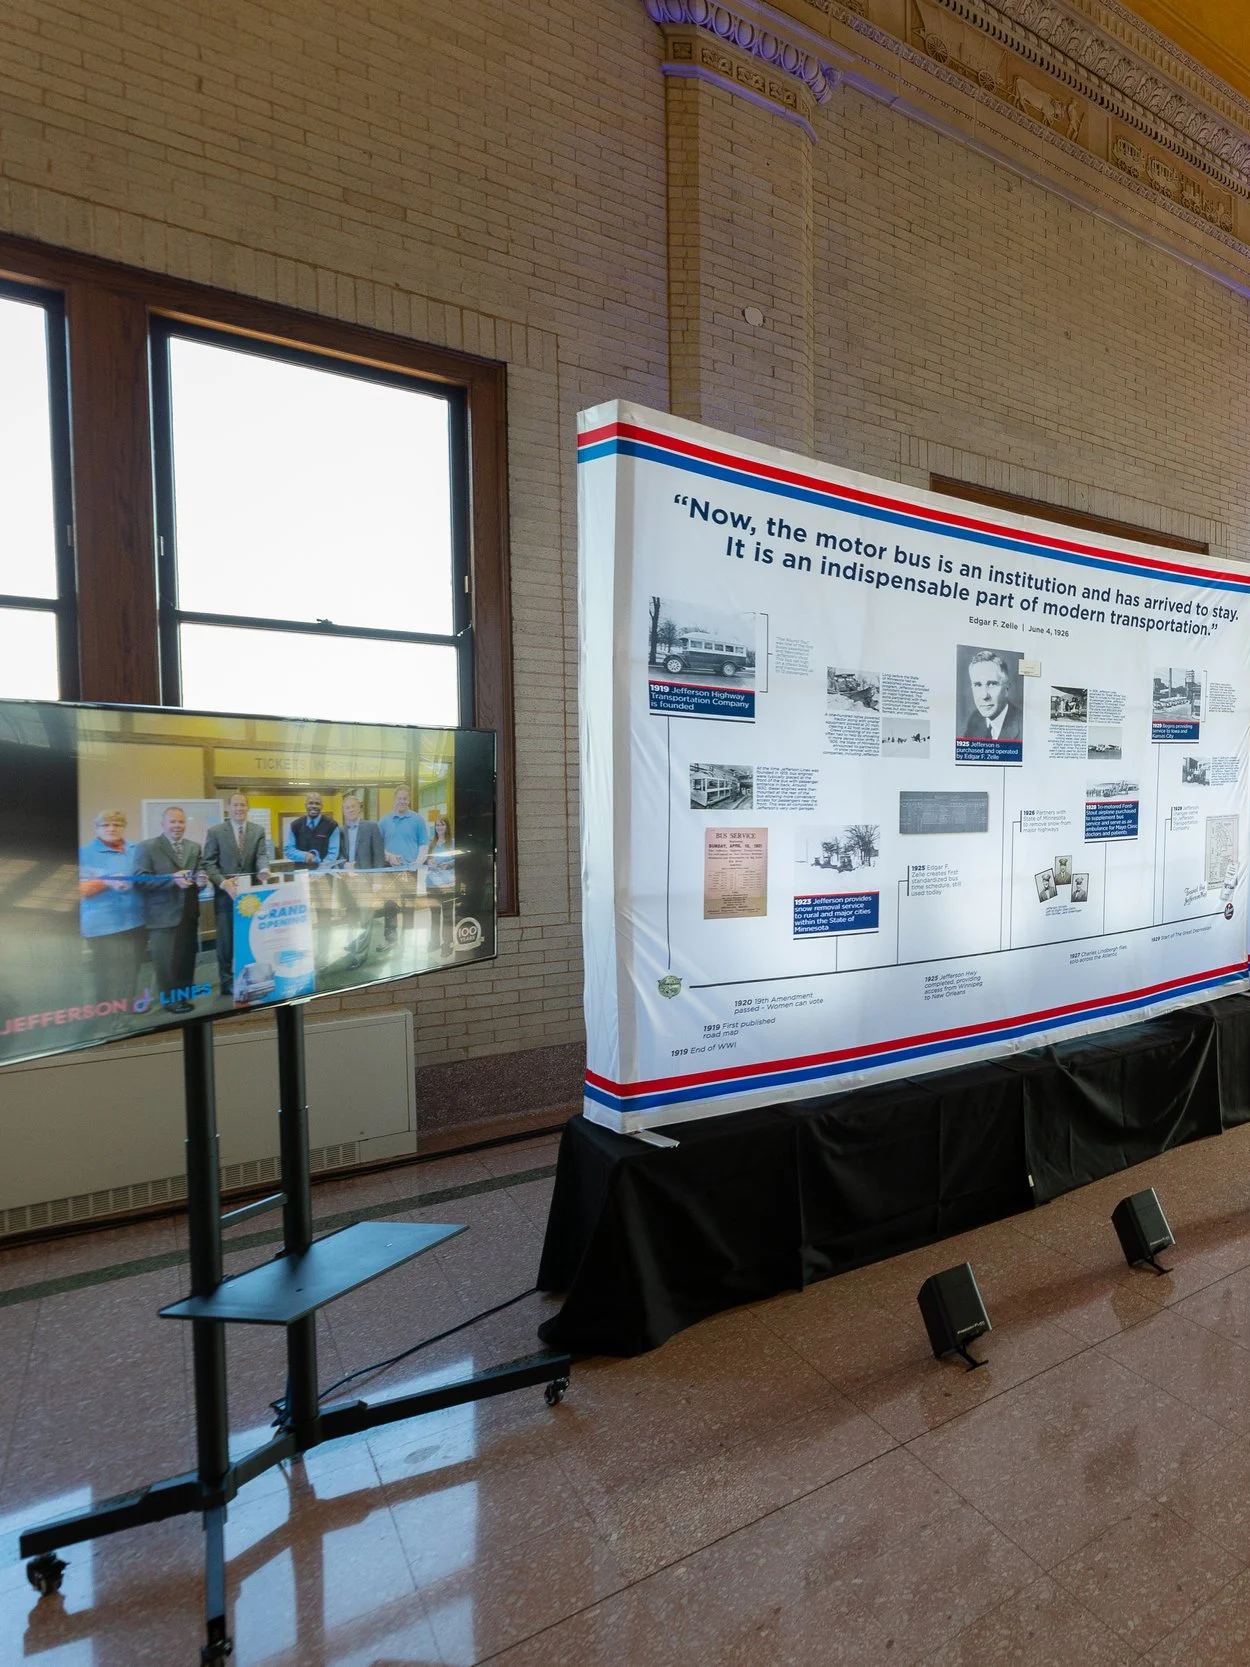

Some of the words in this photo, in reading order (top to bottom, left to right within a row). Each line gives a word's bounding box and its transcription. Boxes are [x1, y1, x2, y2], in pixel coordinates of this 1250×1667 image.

[674, 494, 756, 536] “Now,
[767, 518, 806, 542] the
[816, 531, 887, 560] motor
[894, 546, 930, 569] bus
[938, 554, 953, 573] is
[960, 562, 982, 580] an
[988, 565, 1076, 597] institution
[1082, 584, 1110, 603] and
[1116, 589, 1140, 607] has
[1144, 592, 1192, 615] arrived
[1196, 602, 1208, 616] to
[1212, 606, 1238, 622] stay.
[726, 536, 744, 558] It
[754, 542, 774, 564] is
[782, 552, 811, 572] an
[820, 556, 970, 600] indispensable
[976, 589, 1014, 608] part
[1020, 596, 1039, 612] of
[1044, 601, 1105, 624] modern
[1110, 611, 1218, 636] transportation.”
[968, 616, 990, 628] Edgar
[1000, 620, 1018, 630] Zelle
[1028, 624, 1044, 634] June
[1046, 628, 1053, 636] 4,
[1054, 628, 1070, 638] 1926
[671, 687, 709, 696] Jefferson
[712, 690, 745, 701] Highway
[651, 692, 710, 704] Transportation
[713, 698, 749, 709] Company
[660, 702, 694, 710] founded
[255, 758, 305, 770] TICKETS
[459, 926, 476, 938] 100
[1098, 946, 1118, 954] Lindbergh
[925, 980, 954, 988] completed,
[956, 977, 980, 985] providing
[771, 993, 813, 1002] Amendment
[1, 999, 128, 1036] JEFFERSON
[160, 983, 212, 1005] LINES
[735, 1005, 759, 1014] passed
[741, 1017, 775, 1028] published
[718, 1042, 736, 1050] WWI
